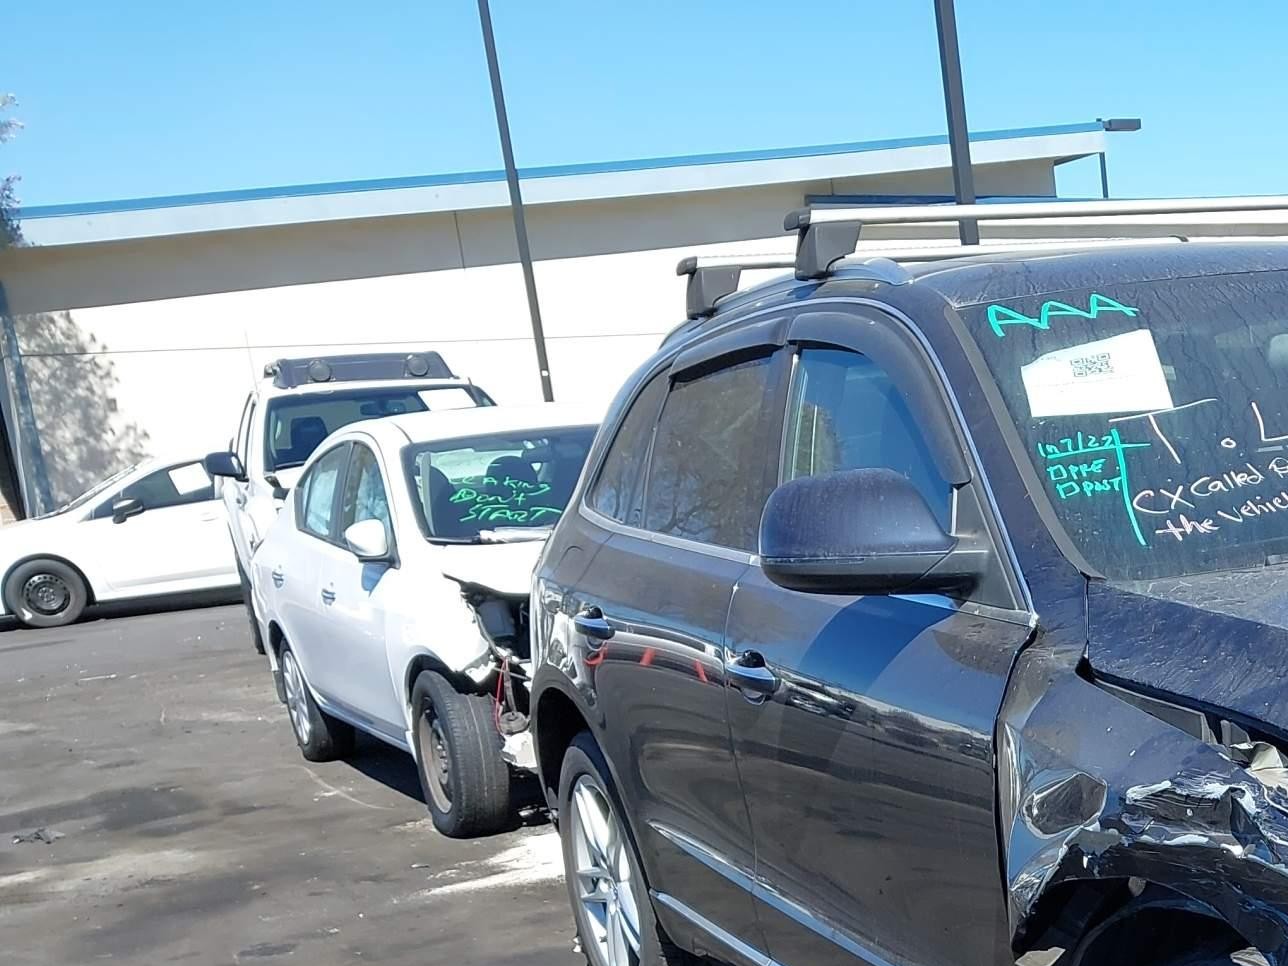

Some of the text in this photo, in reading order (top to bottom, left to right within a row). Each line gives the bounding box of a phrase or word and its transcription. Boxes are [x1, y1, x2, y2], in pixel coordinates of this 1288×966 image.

[987, 293, 1140, 337] AAA
[458, 503, 563, 522] START
[1132, 485, 1196, 514] CX
[1155, 513, 1221, 542] the
